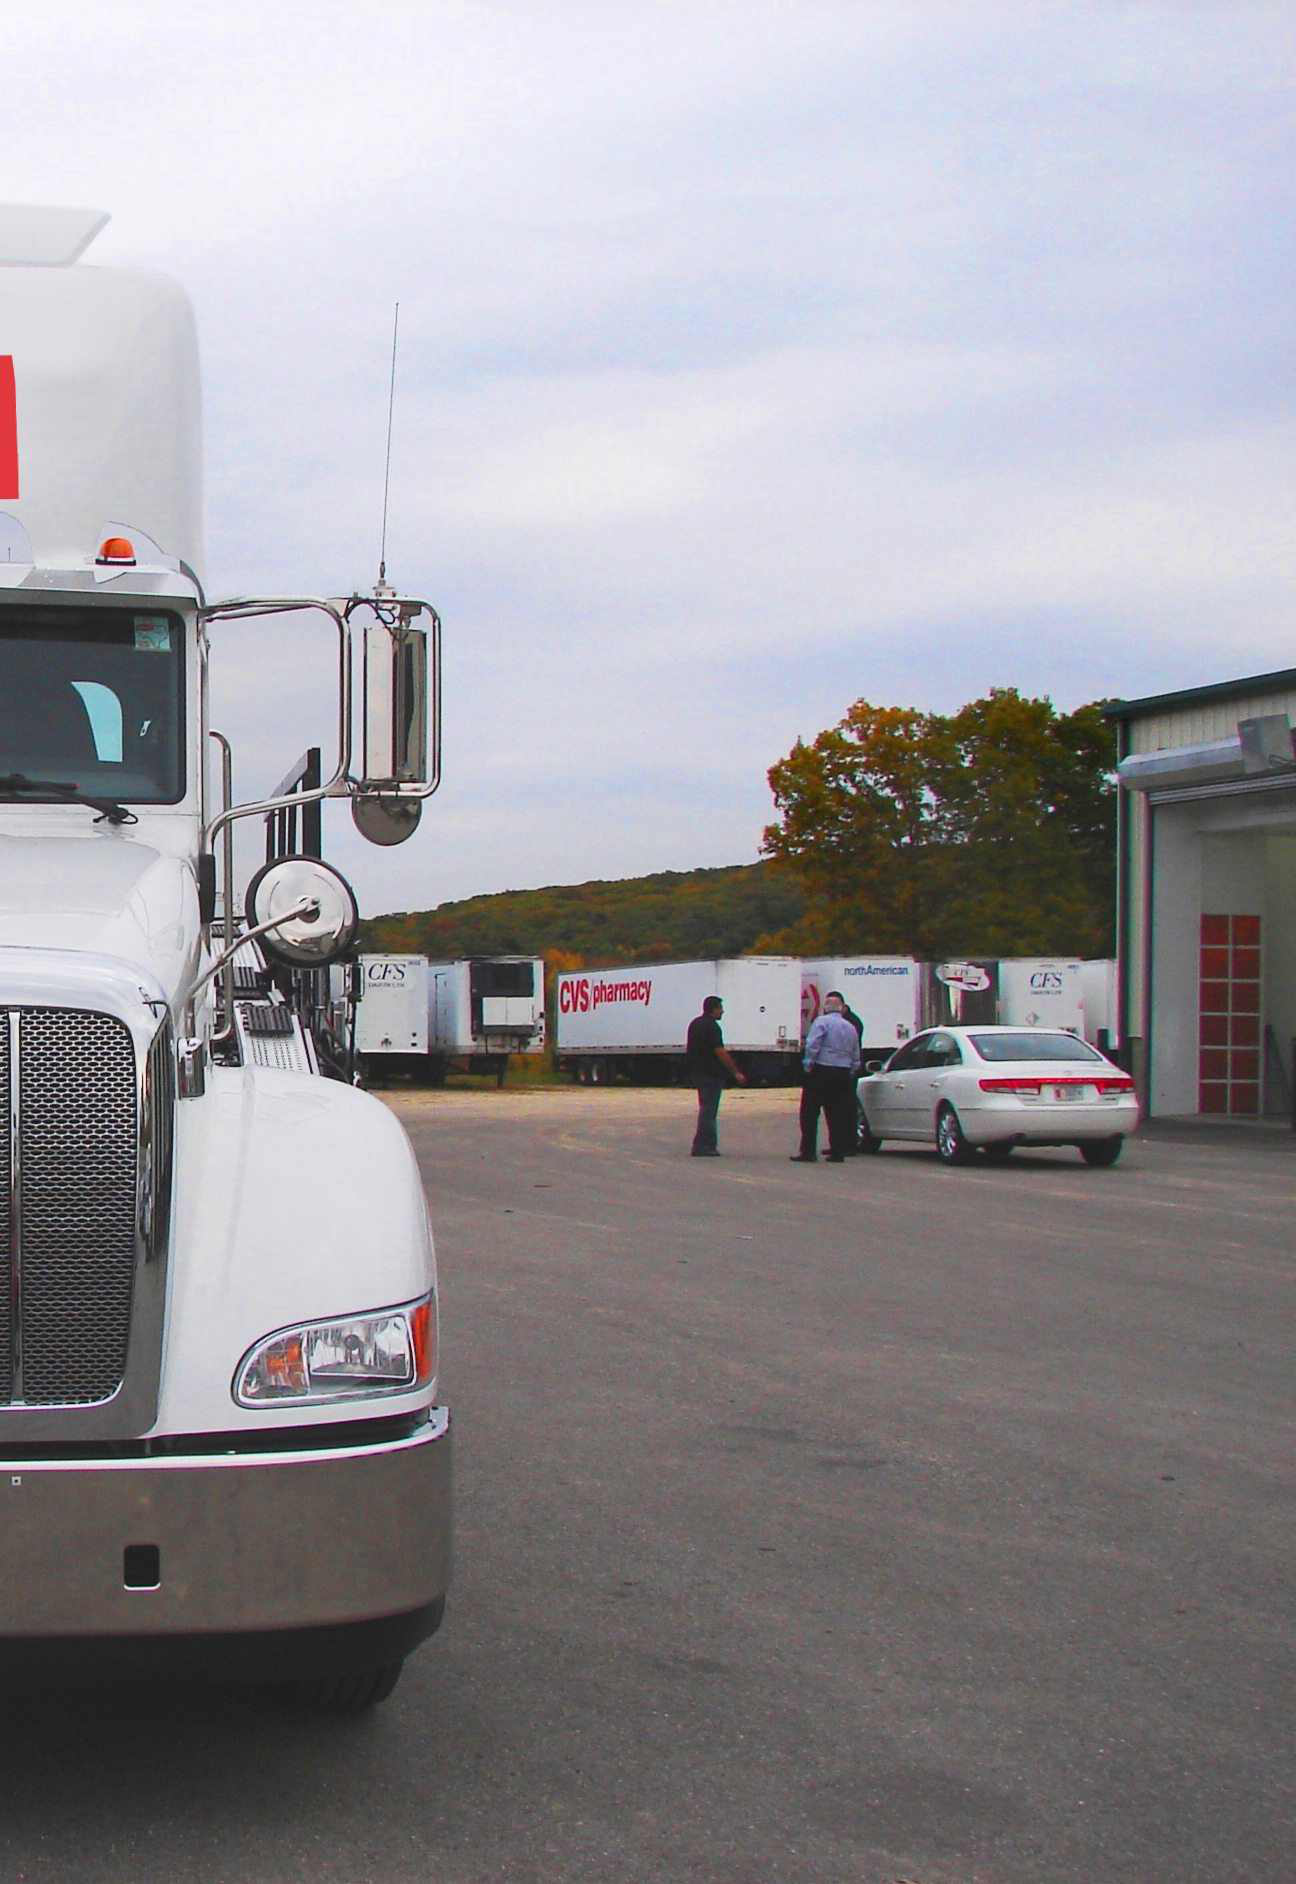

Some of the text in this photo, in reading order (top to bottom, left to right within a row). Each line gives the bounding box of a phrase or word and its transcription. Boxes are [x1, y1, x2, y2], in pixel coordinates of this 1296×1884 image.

[368, 962, 406, 981] CFS
[844, 964, 909, 976] northAmerican
[1030, 971, 1063, 988] CFS
[560, 979, 652, 1013] CVS pharmacy
